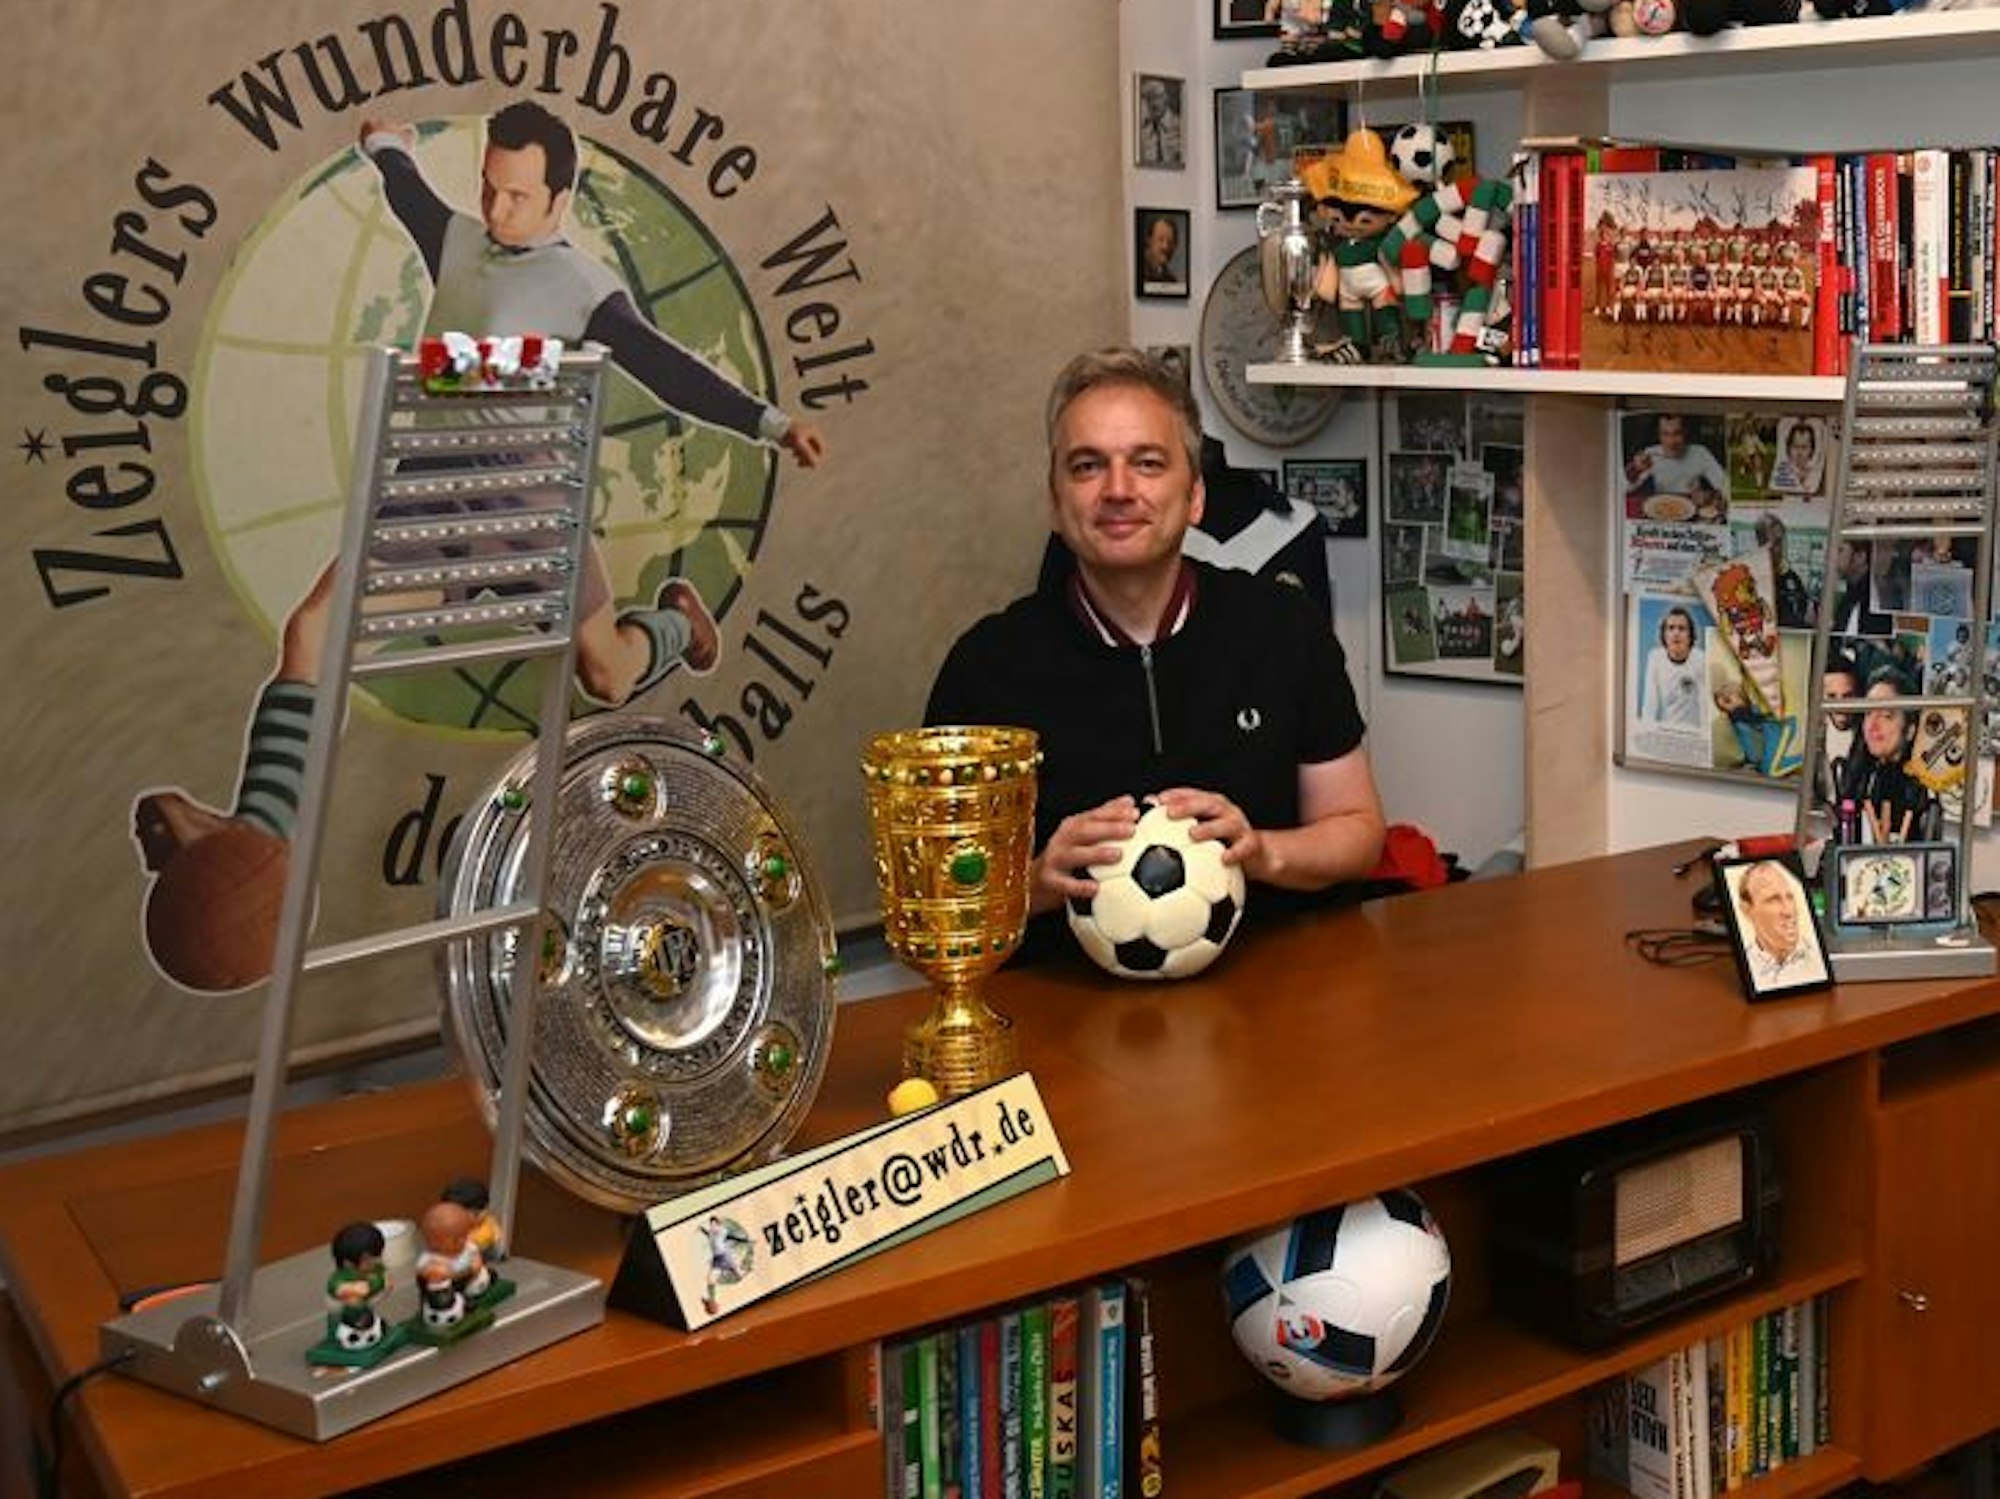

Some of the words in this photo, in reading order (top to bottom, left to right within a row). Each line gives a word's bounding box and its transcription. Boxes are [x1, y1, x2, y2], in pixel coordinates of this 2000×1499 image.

[17, 156, 219, 611] Zeiglers
[207, 0, 759, 201] wunderbare
[760, 203, 877, 411] Welt
[762, 1101, 1036, 1258] zeigler@wdr.de
